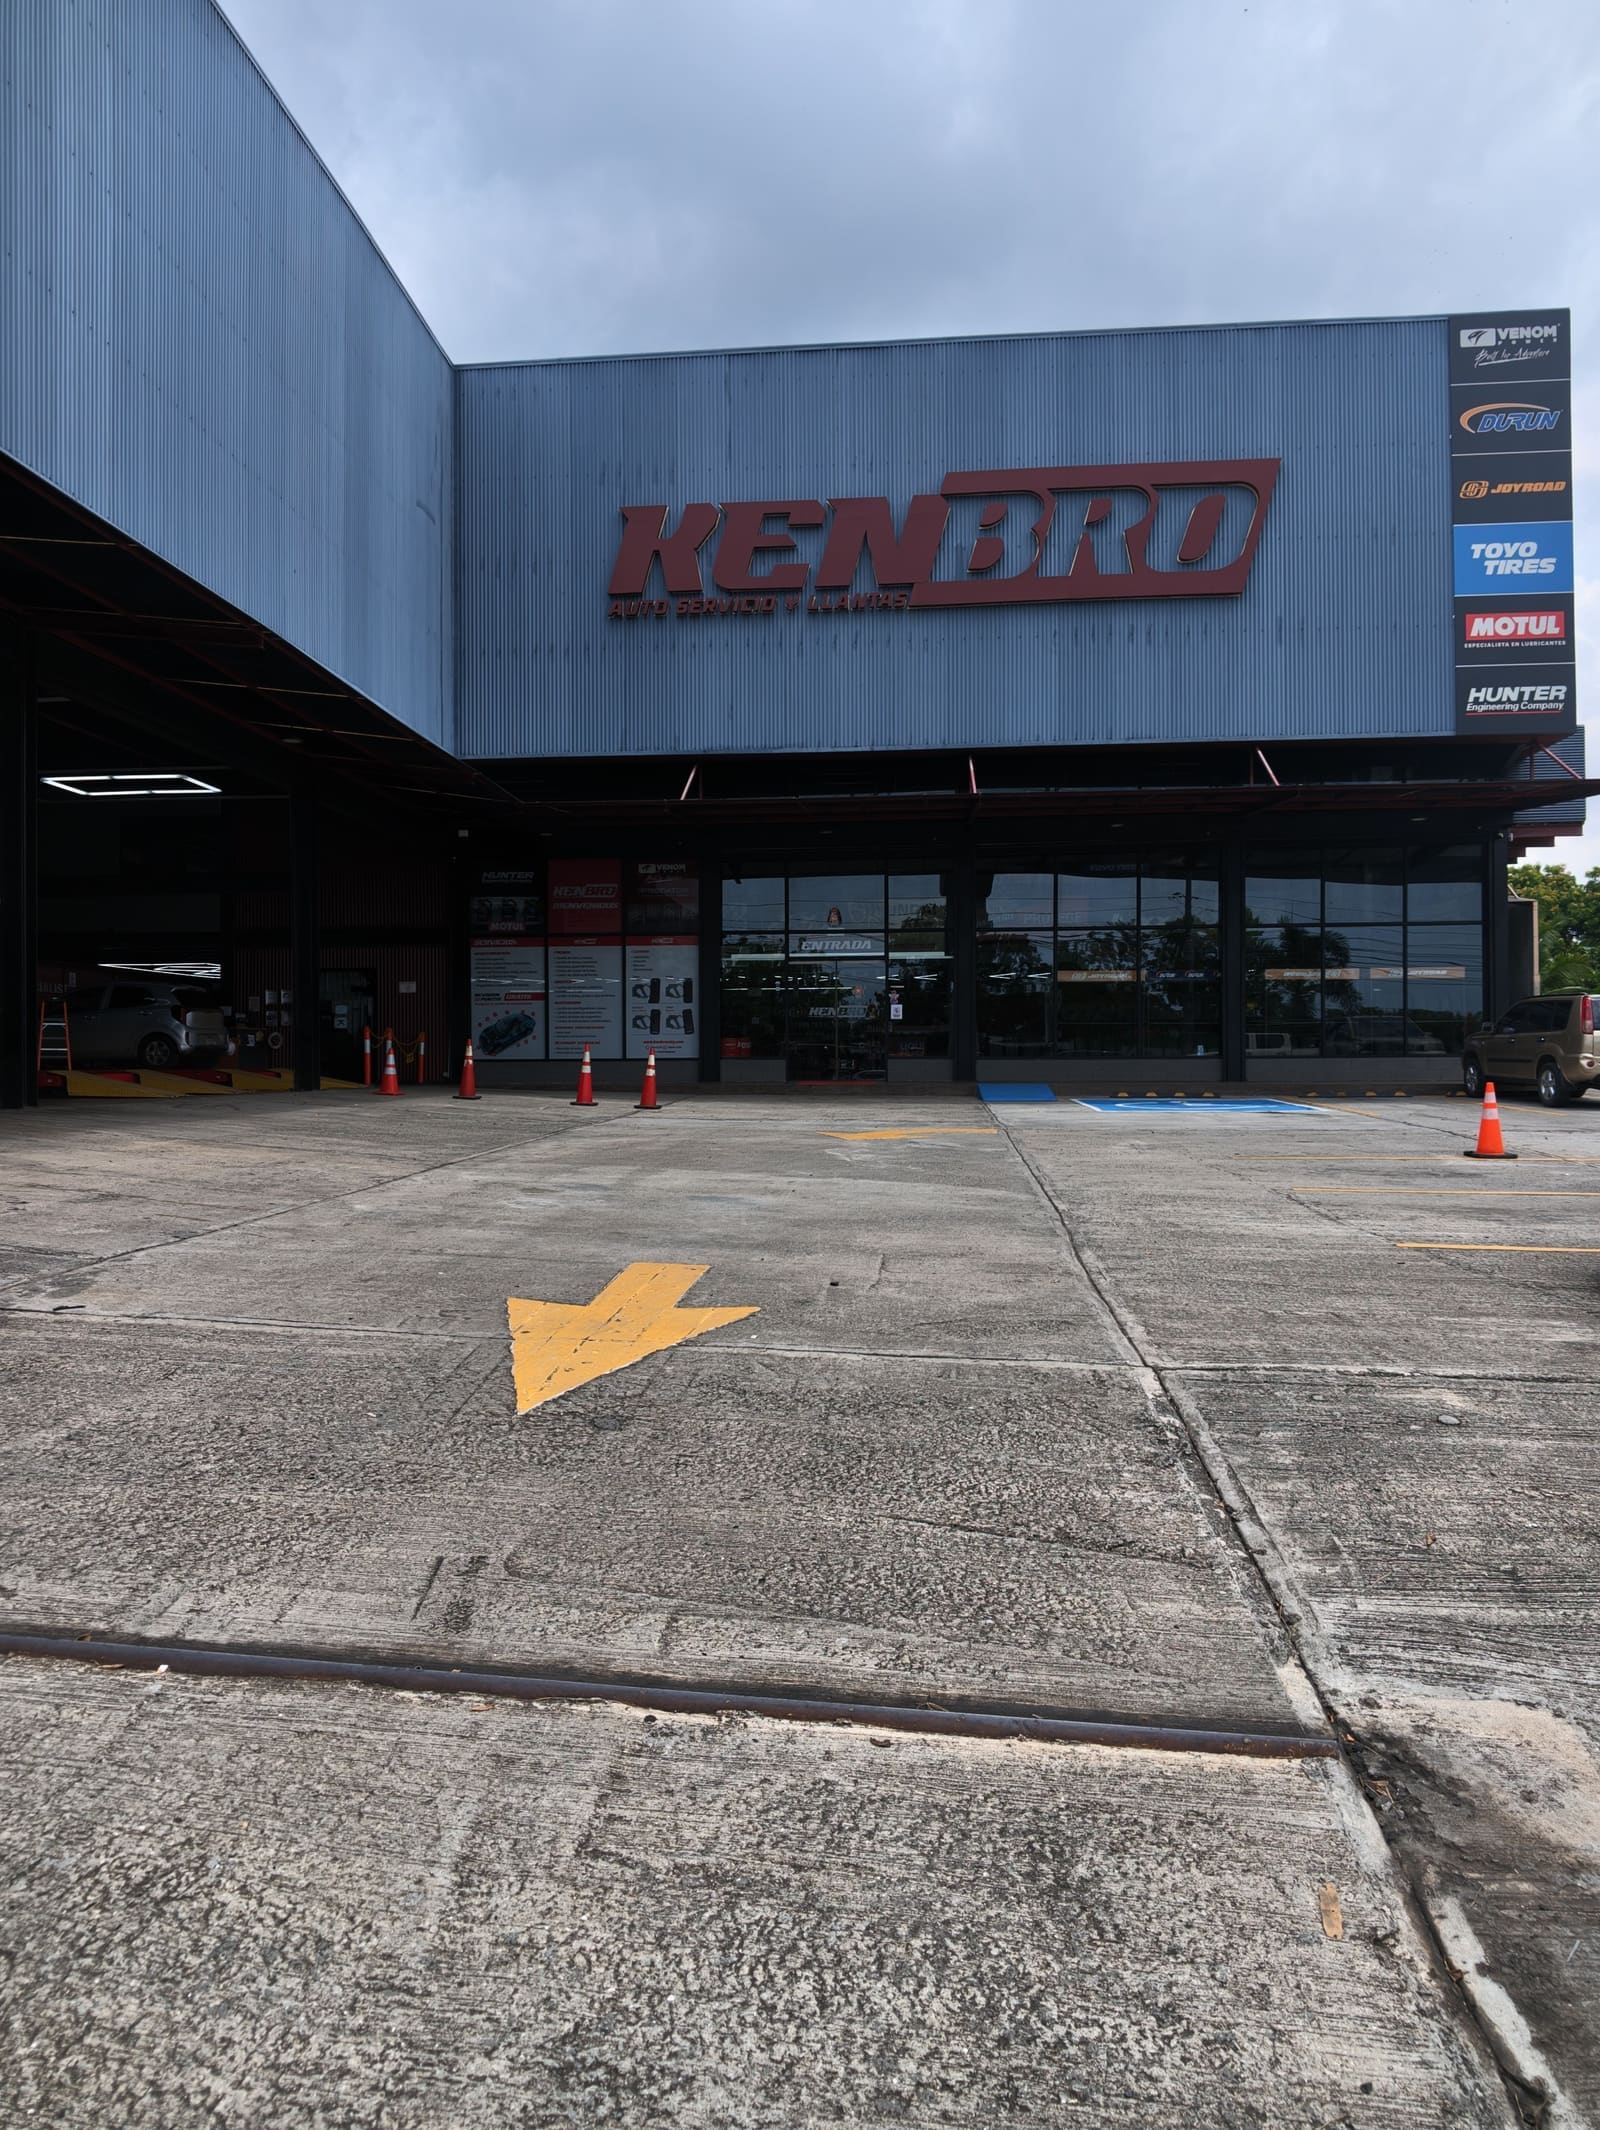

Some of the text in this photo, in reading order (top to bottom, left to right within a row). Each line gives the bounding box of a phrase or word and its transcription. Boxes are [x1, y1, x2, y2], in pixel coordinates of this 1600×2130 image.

[1497, 325, 1557, 340] VENOM
[1477, 411, 1560, 432] DURUN
[1491, 481, 1566, 494] JOYROAD
[607, 457, 1282, 608] KENBRO
[1471, 541, 1538, 559] TOYO
[1484, 557, 1557, 576] TIRES
[608, 591, 907, 618] AUTO SERVICIO Y LLANTAS
[1470, 615, 1560, 637] MOTUL
[1468, 685, 1567, 702] HUNTER
[1466, 701, 1565, 712] Engineering Company
[481, 871, 535, 882] HUNTER
[801, 940, 872, 951] ENTRADA
